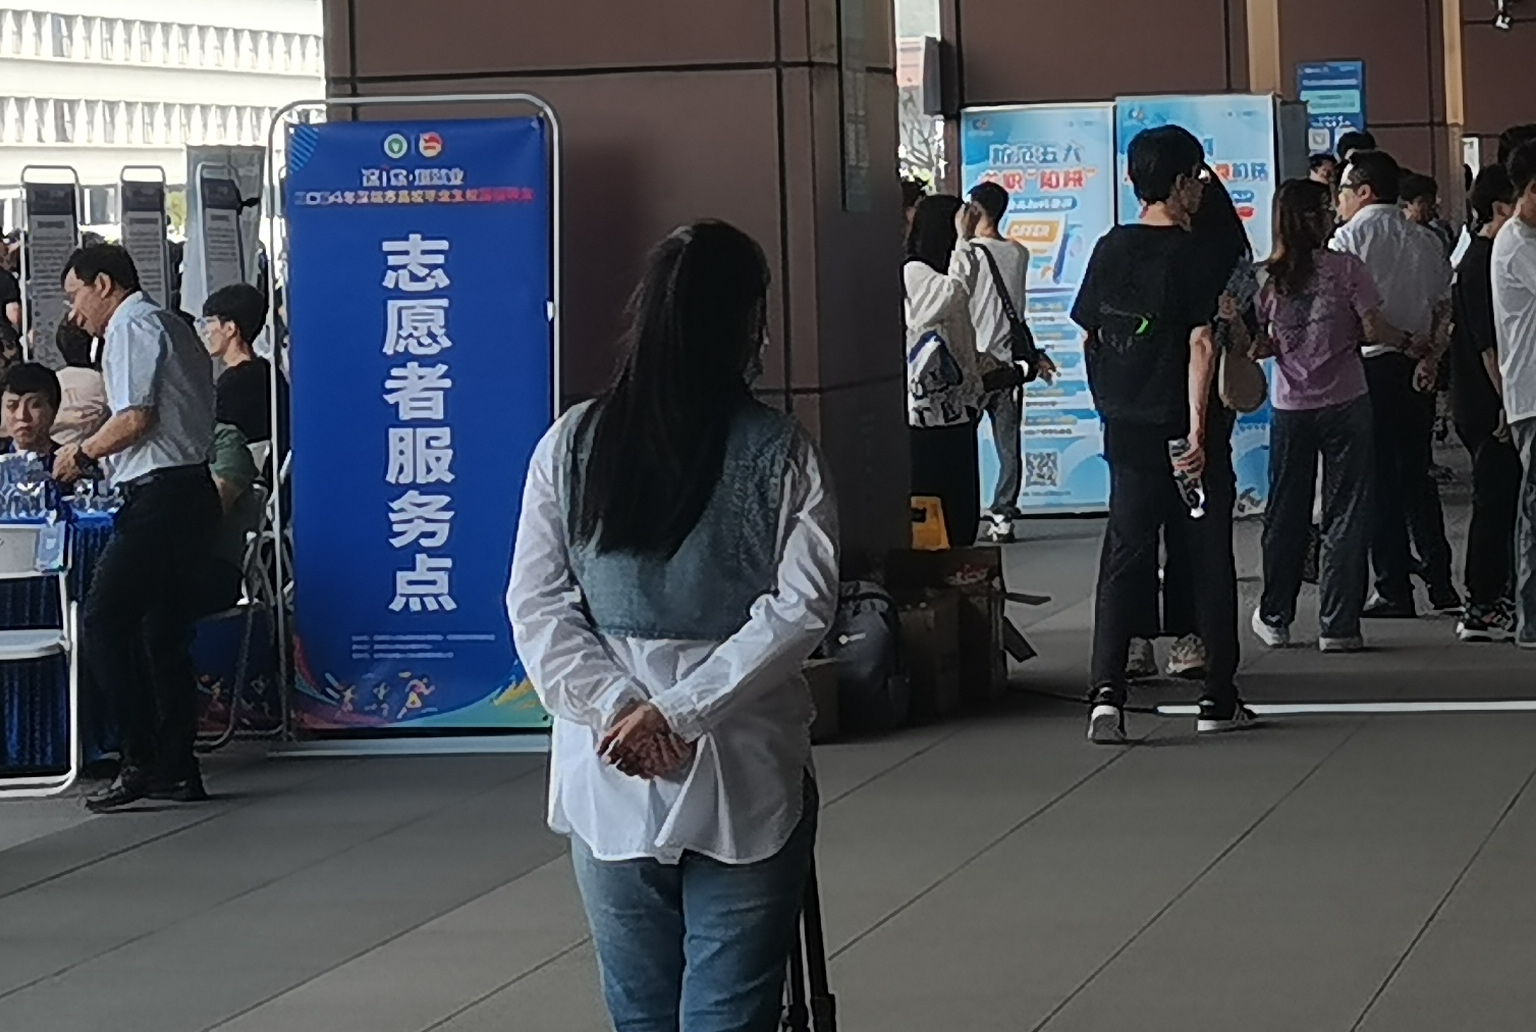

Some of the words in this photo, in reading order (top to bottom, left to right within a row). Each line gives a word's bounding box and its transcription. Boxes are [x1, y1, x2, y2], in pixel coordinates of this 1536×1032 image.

[381, 233, 457, 613] 志愿者服务点
